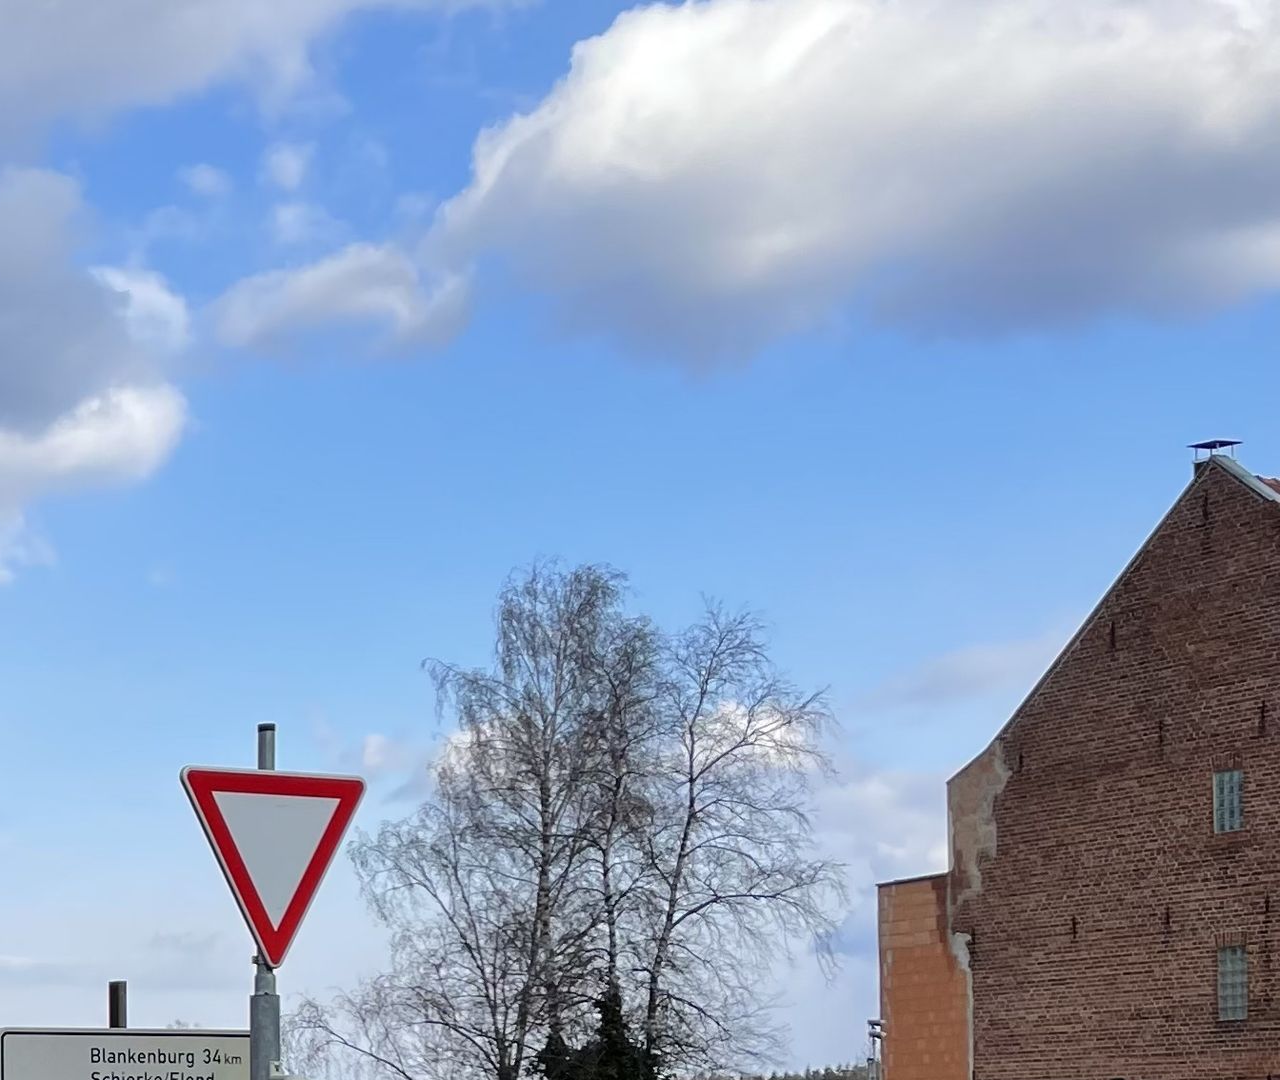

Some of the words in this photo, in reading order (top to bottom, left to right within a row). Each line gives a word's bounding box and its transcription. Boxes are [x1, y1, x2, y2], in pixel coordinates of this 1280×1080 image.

[90, 1048, 195, 1068] Blankenburg
[202, 1049, 221, 1064] 34
[224, 1053, 242, 1065] km
